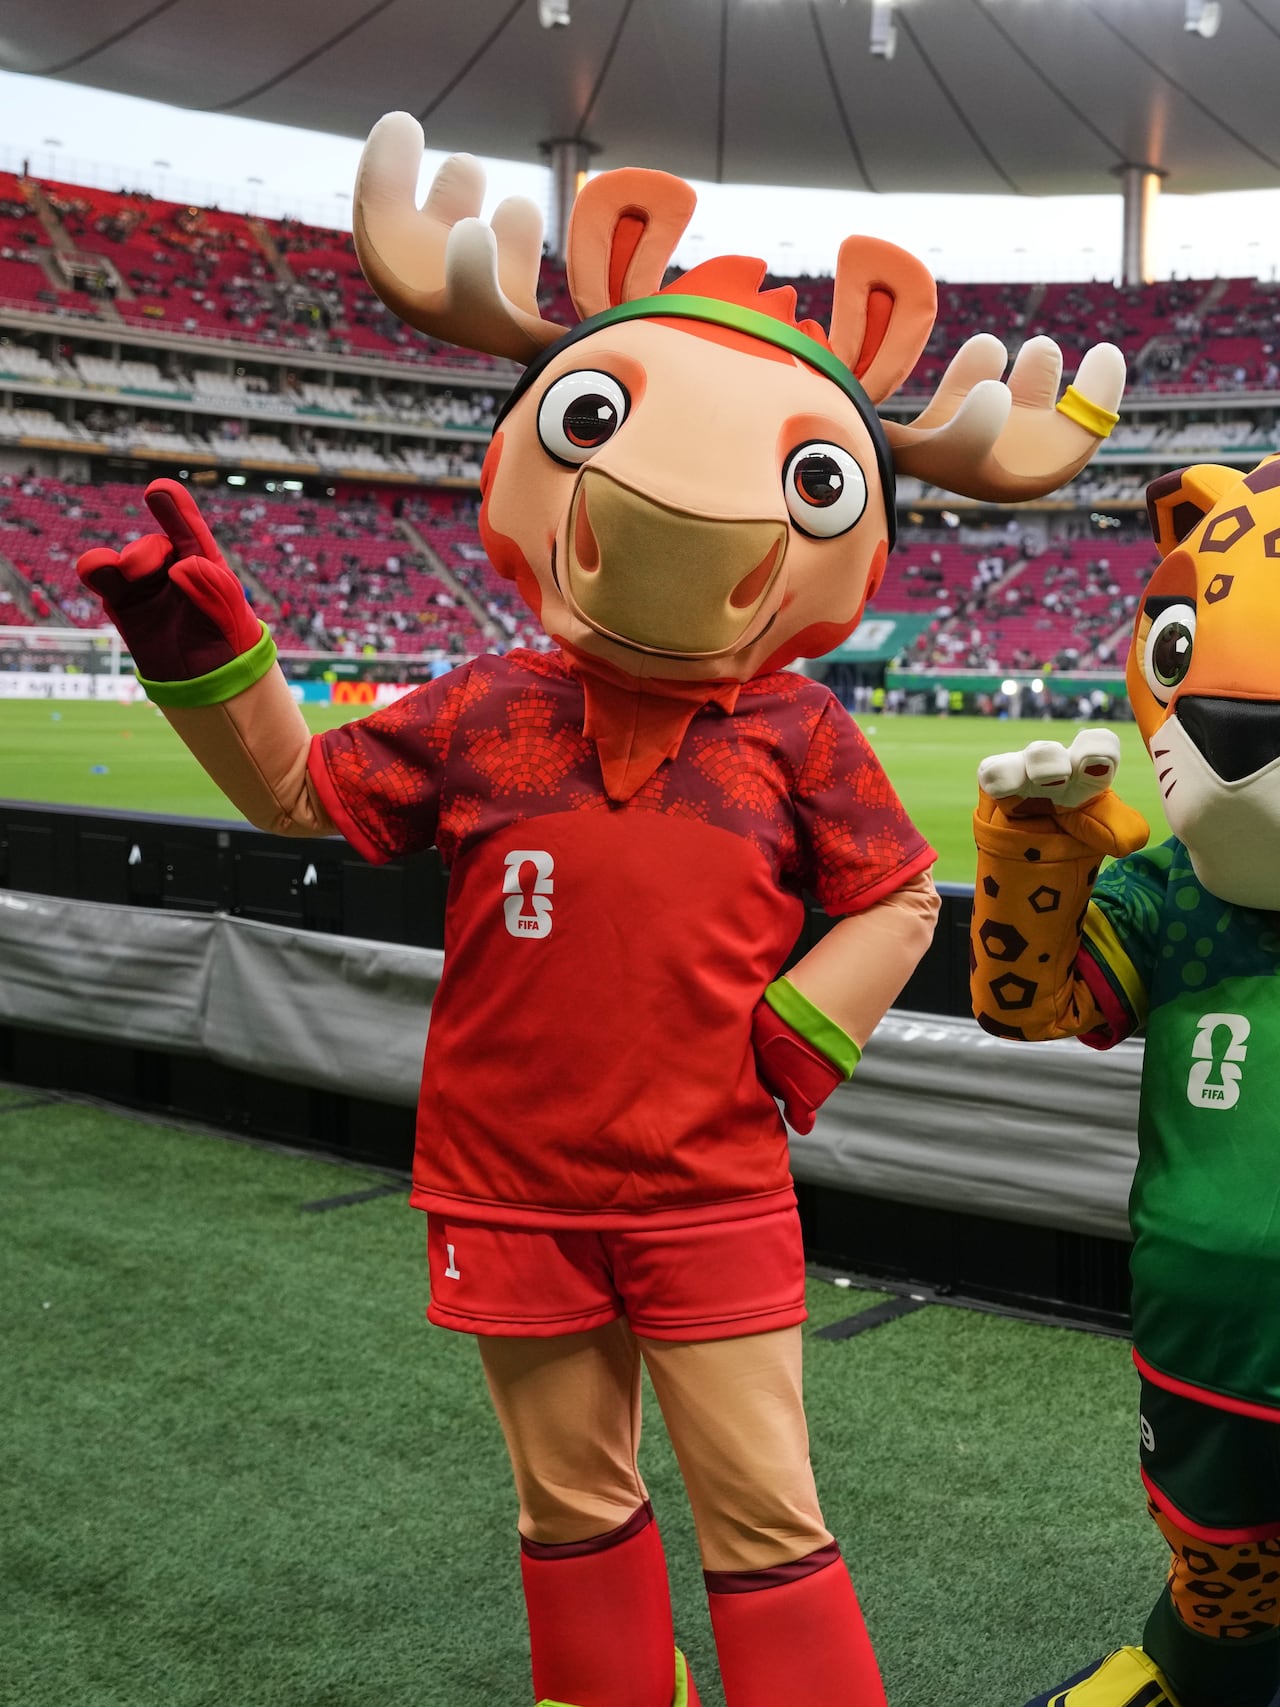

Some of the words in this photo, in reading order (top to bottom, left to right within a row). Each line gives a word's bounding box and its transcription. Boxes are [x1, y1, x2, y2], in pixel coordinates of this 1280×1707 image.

[518, 920, 540, 930] FIFA
[1201, 1089, 1225, 1101] FIFA
[444, 1243, 461, 1280] 1
